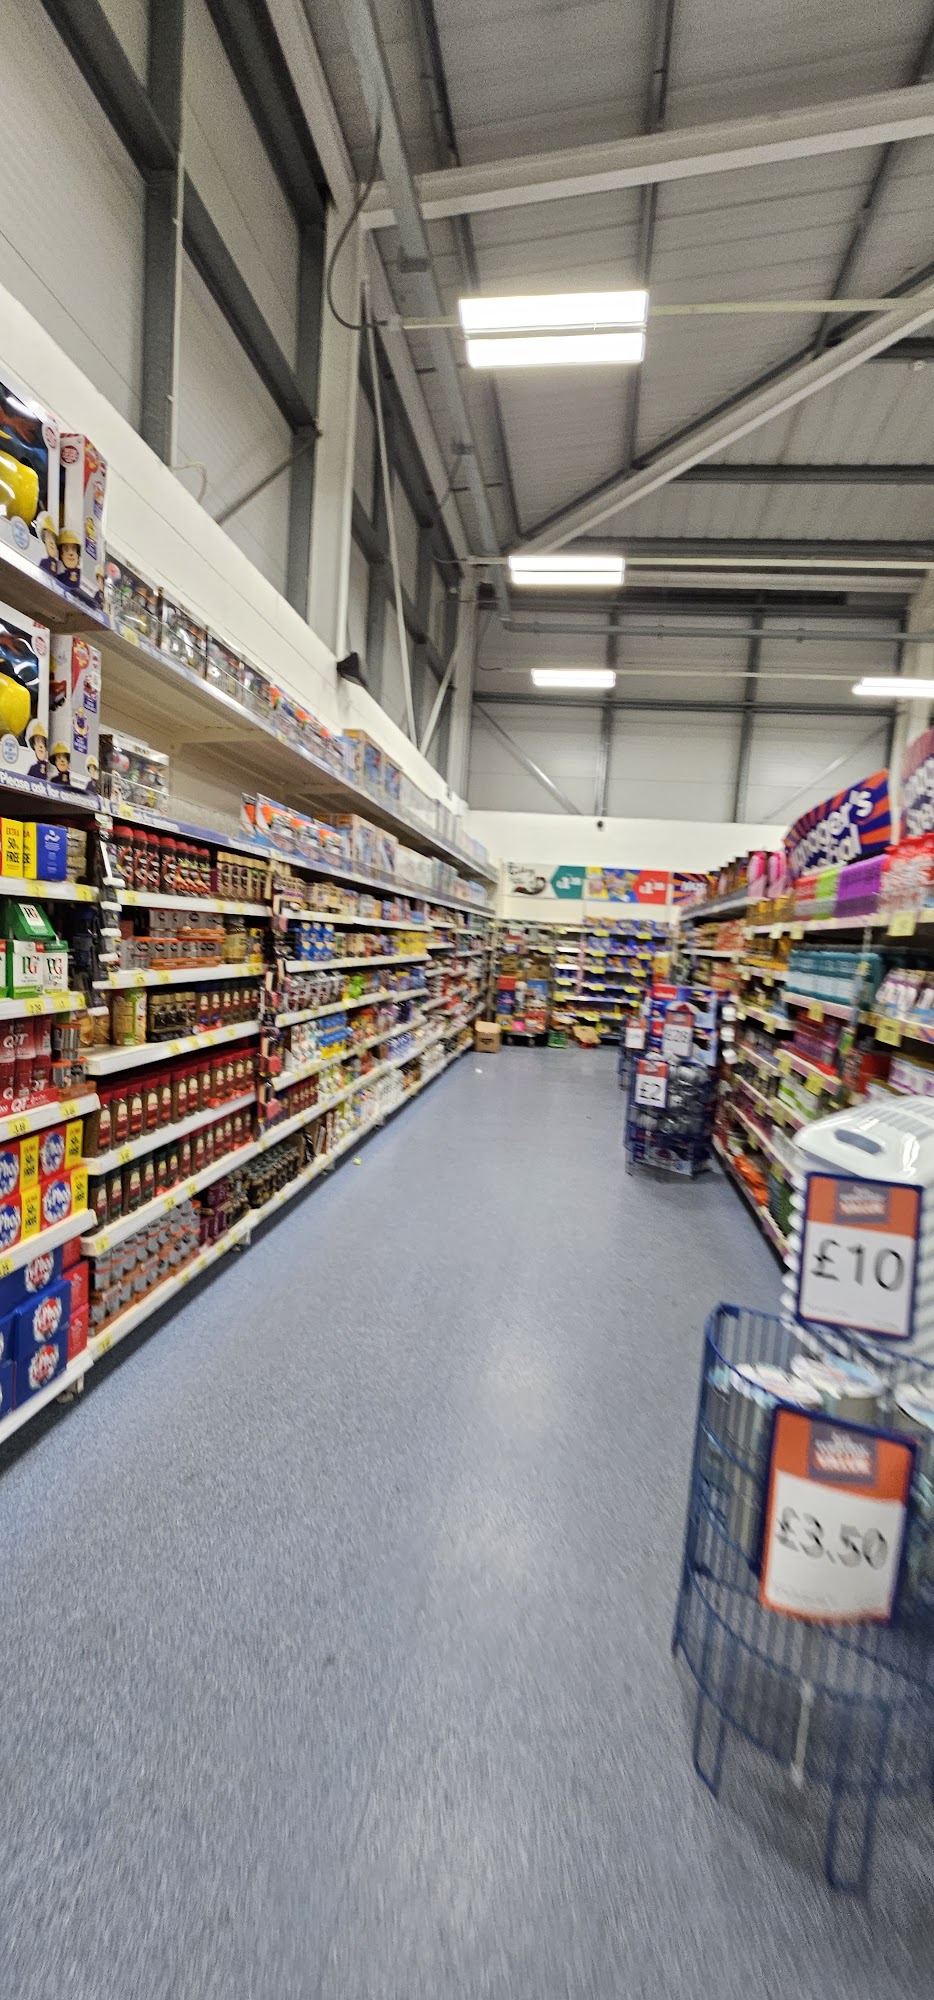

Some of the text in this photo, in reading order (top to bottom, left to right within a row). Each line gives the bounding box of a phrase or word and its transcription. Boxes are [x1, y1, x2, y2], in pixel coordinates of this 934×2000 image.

[31, 781, 47, 795] ask
[6, 827, 20, 837] EXTRA
[6, 850, 20, 864] FREE
[22, 955, 38, 975] PG
[46, 957, 63, 976] PG
[811, 1239, 905, 1292] £10
[775, 1506, 889, 1571] £3.50
